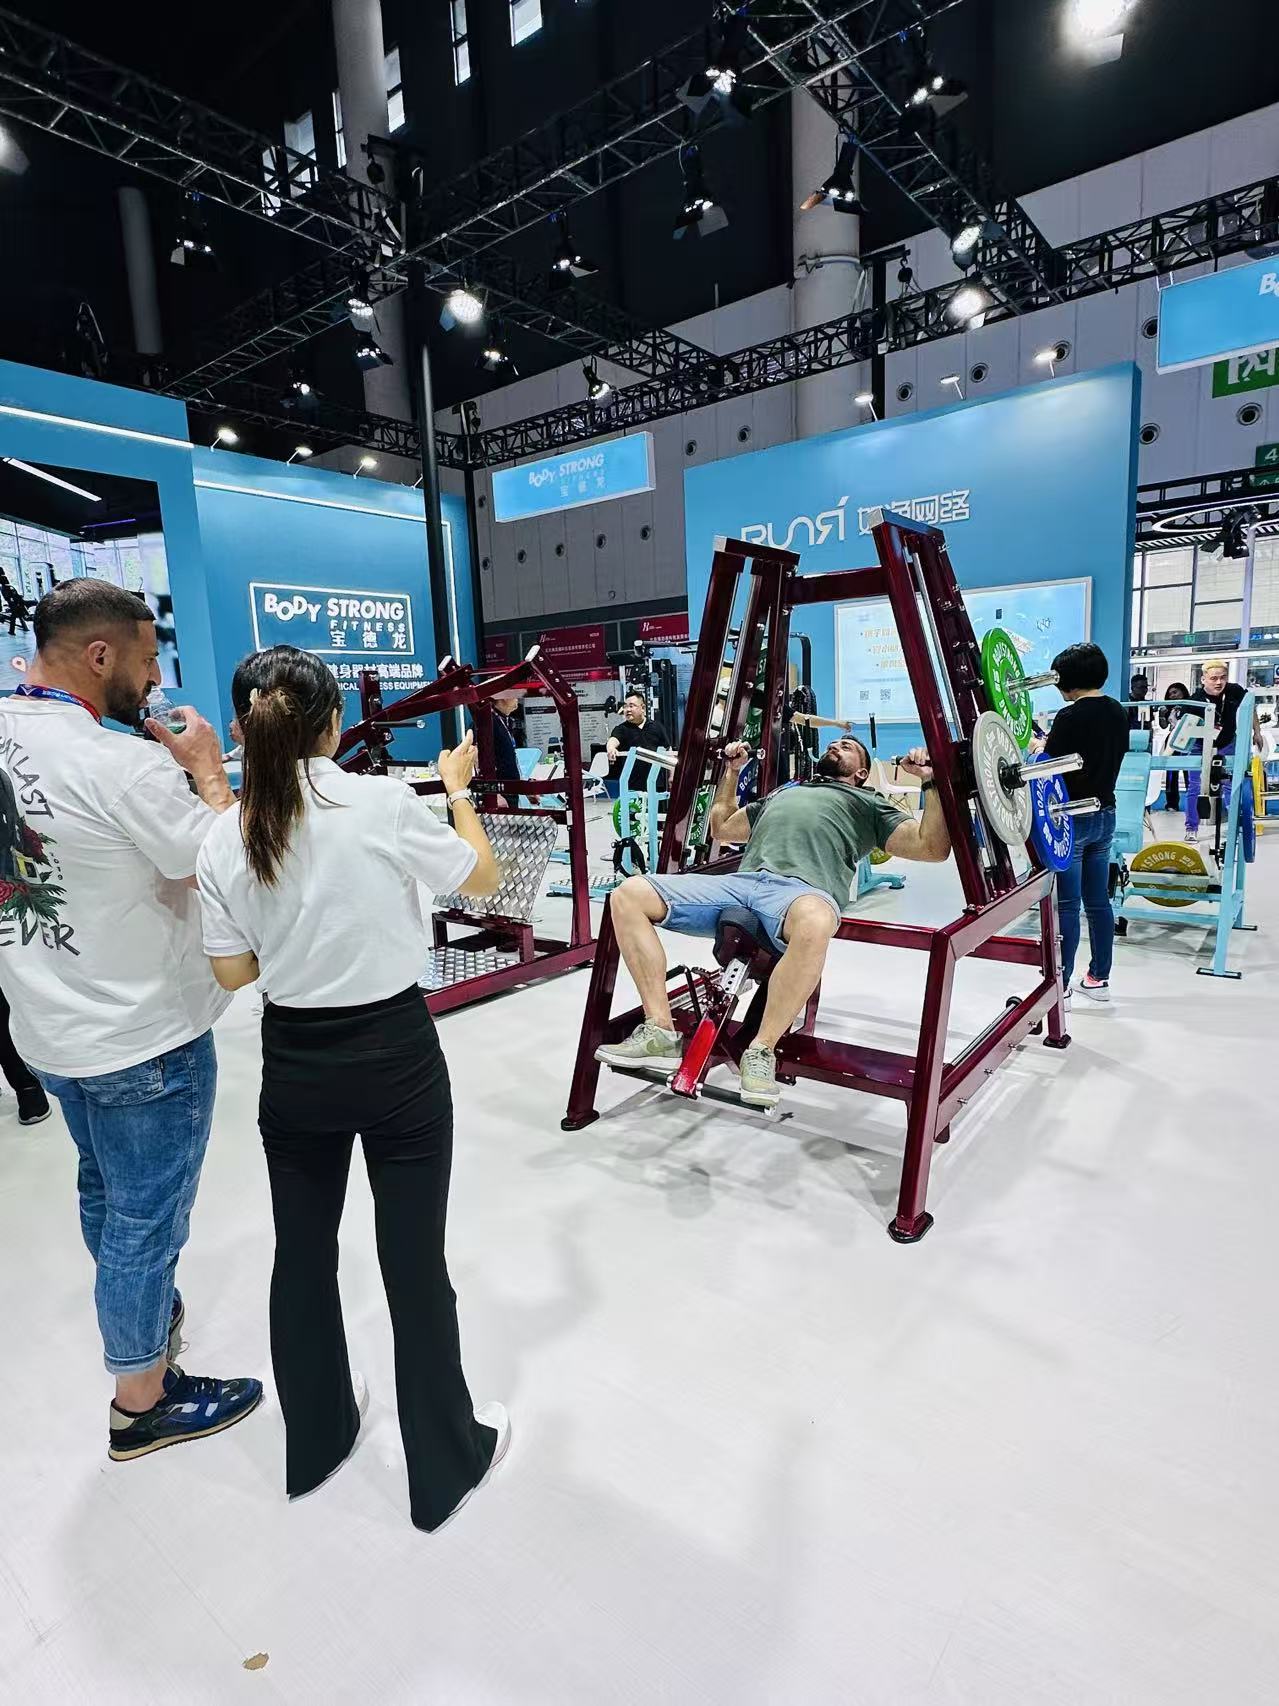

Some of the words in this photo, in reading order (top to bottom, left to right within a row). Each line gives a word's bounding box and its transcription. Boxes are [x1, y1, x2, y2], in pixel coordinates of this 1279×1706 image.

[559, 453, 605, 477] STRONG
[264, 593, 321, 622] BODY
[327, 597, 405, 621] STRONG
[330, 620, 406, 633] FITNESS
[331, 630, 407, 649] 宝德龙
[13, 755, 55, 820] LAST
